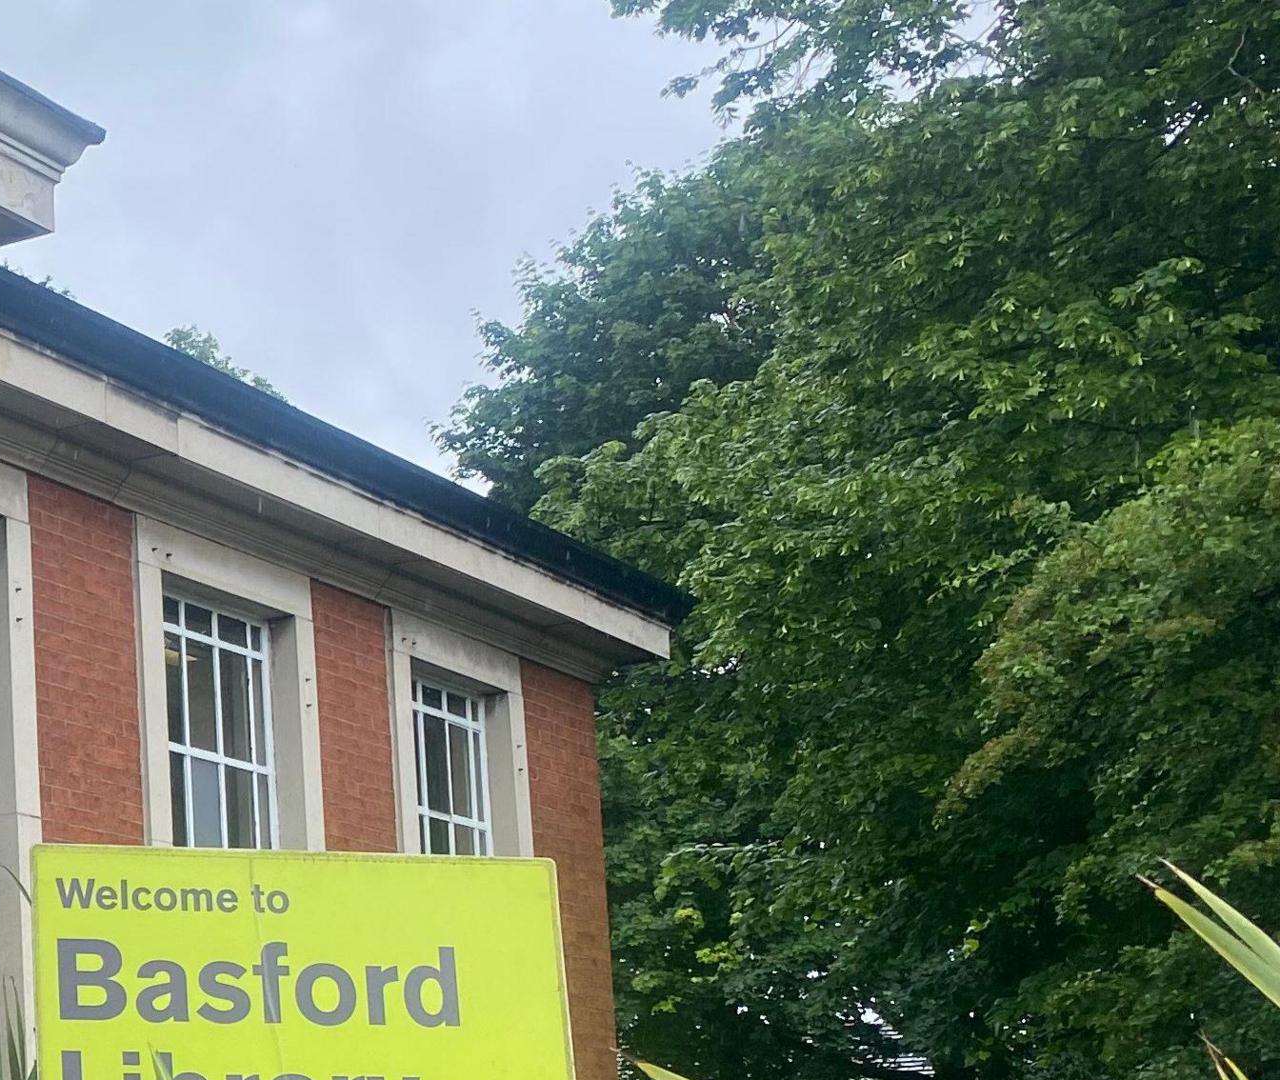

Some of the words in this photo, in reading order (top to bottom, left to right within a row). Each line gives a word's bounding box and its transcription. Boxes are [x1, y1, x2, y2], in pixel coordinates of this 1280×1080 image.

[56, 878, 238, 913] Welcome
[251, 884, 289, 914] to
[57, 938, 460, 1028] Basford
